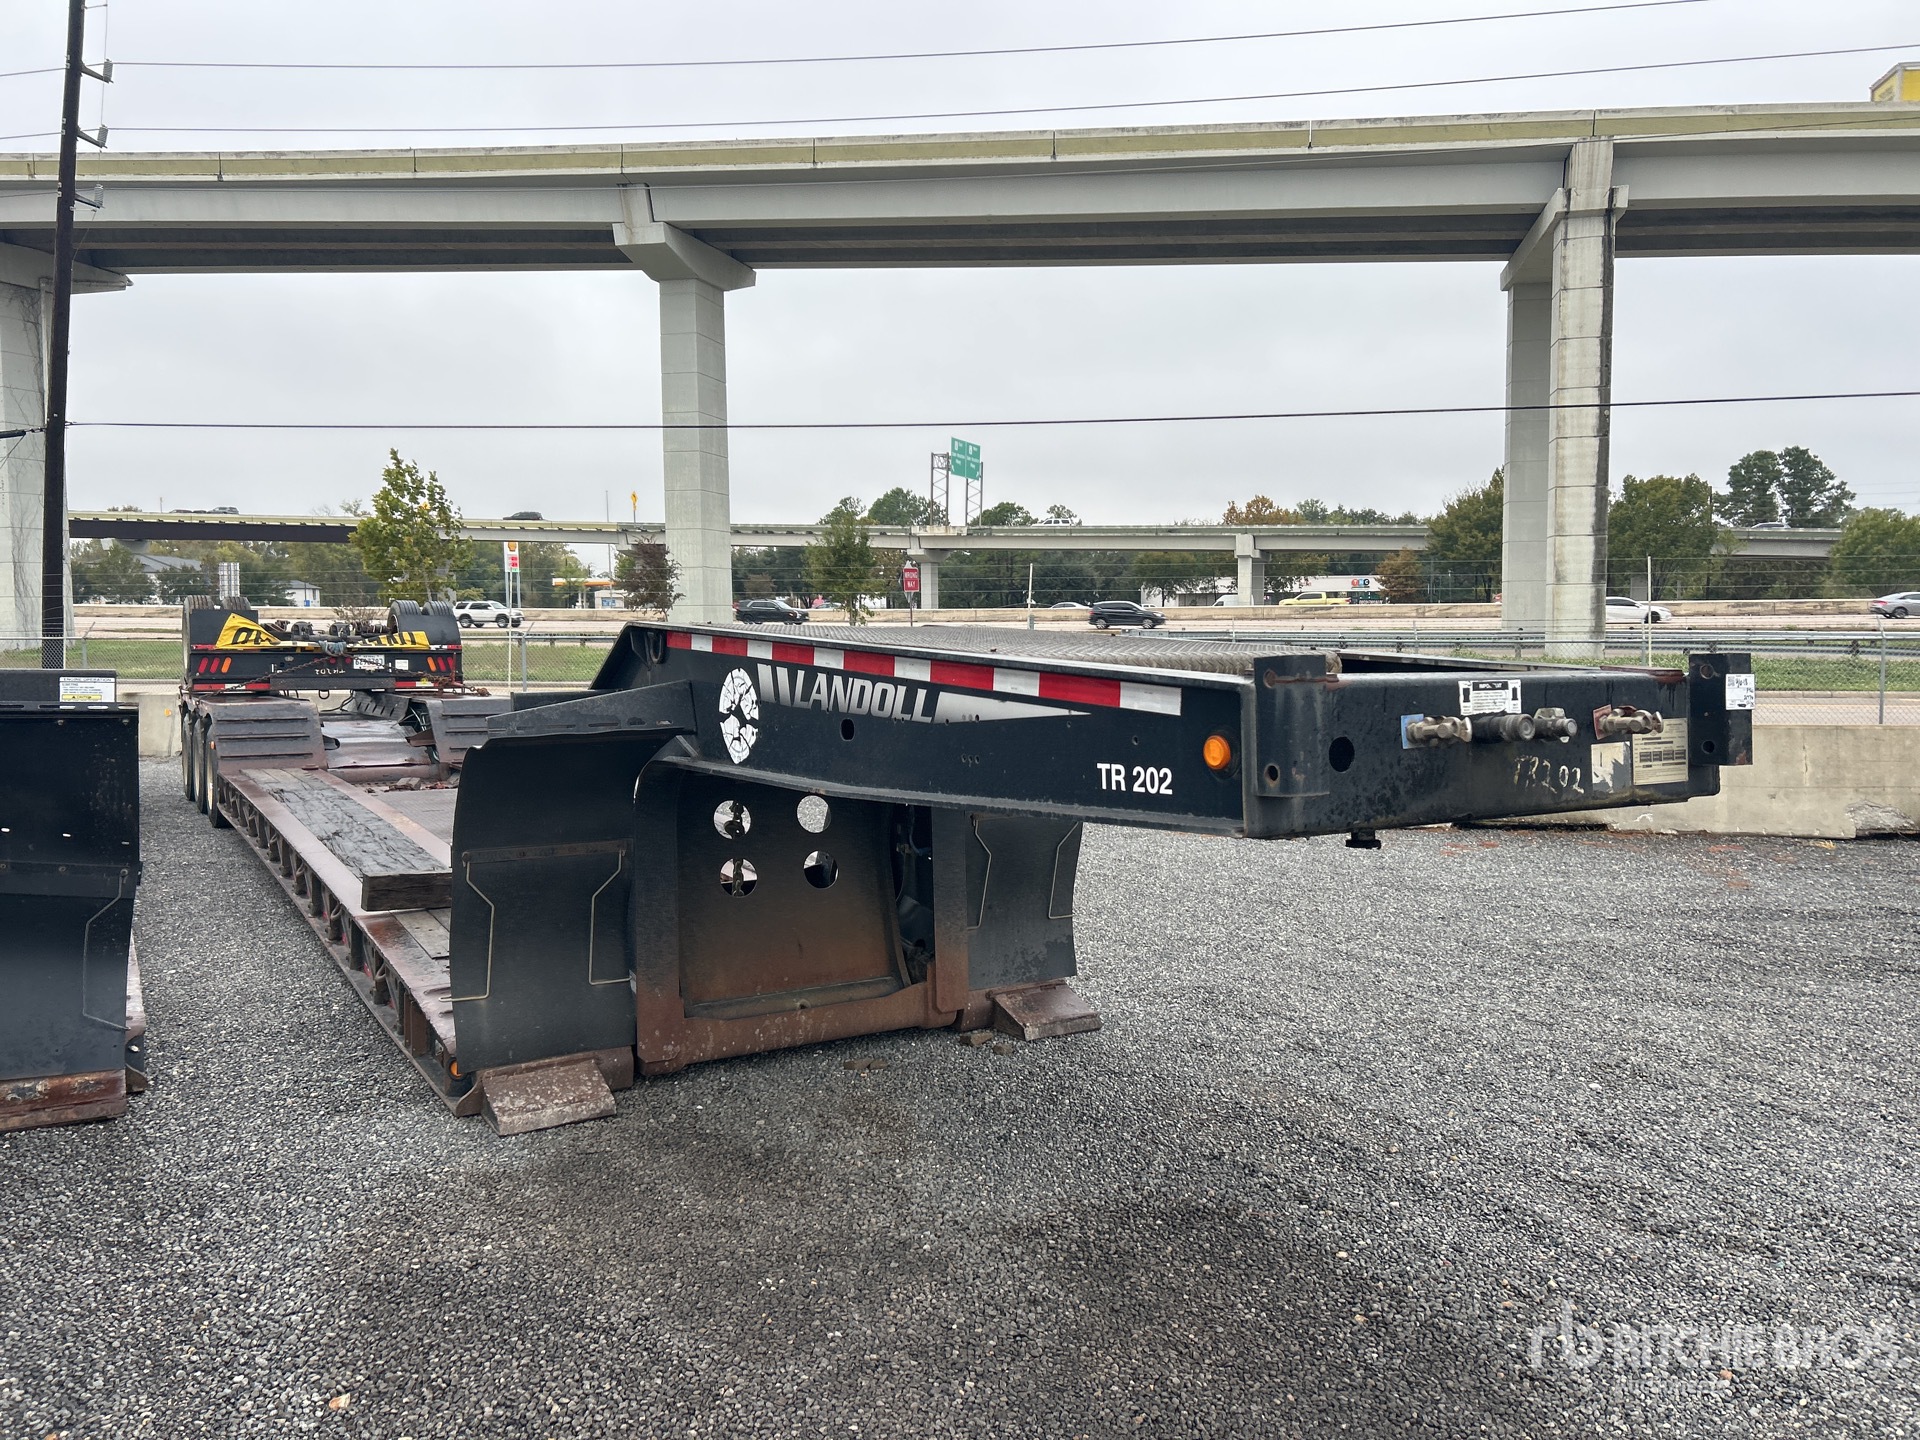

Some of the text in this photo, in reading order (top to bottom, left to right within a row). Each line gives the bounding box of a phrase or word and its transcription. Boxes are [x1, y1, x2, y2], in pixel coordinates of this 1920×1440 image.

[792, 669, 932, 724] LANDOLL
[1096, 762, 1173, 795] TR 202
